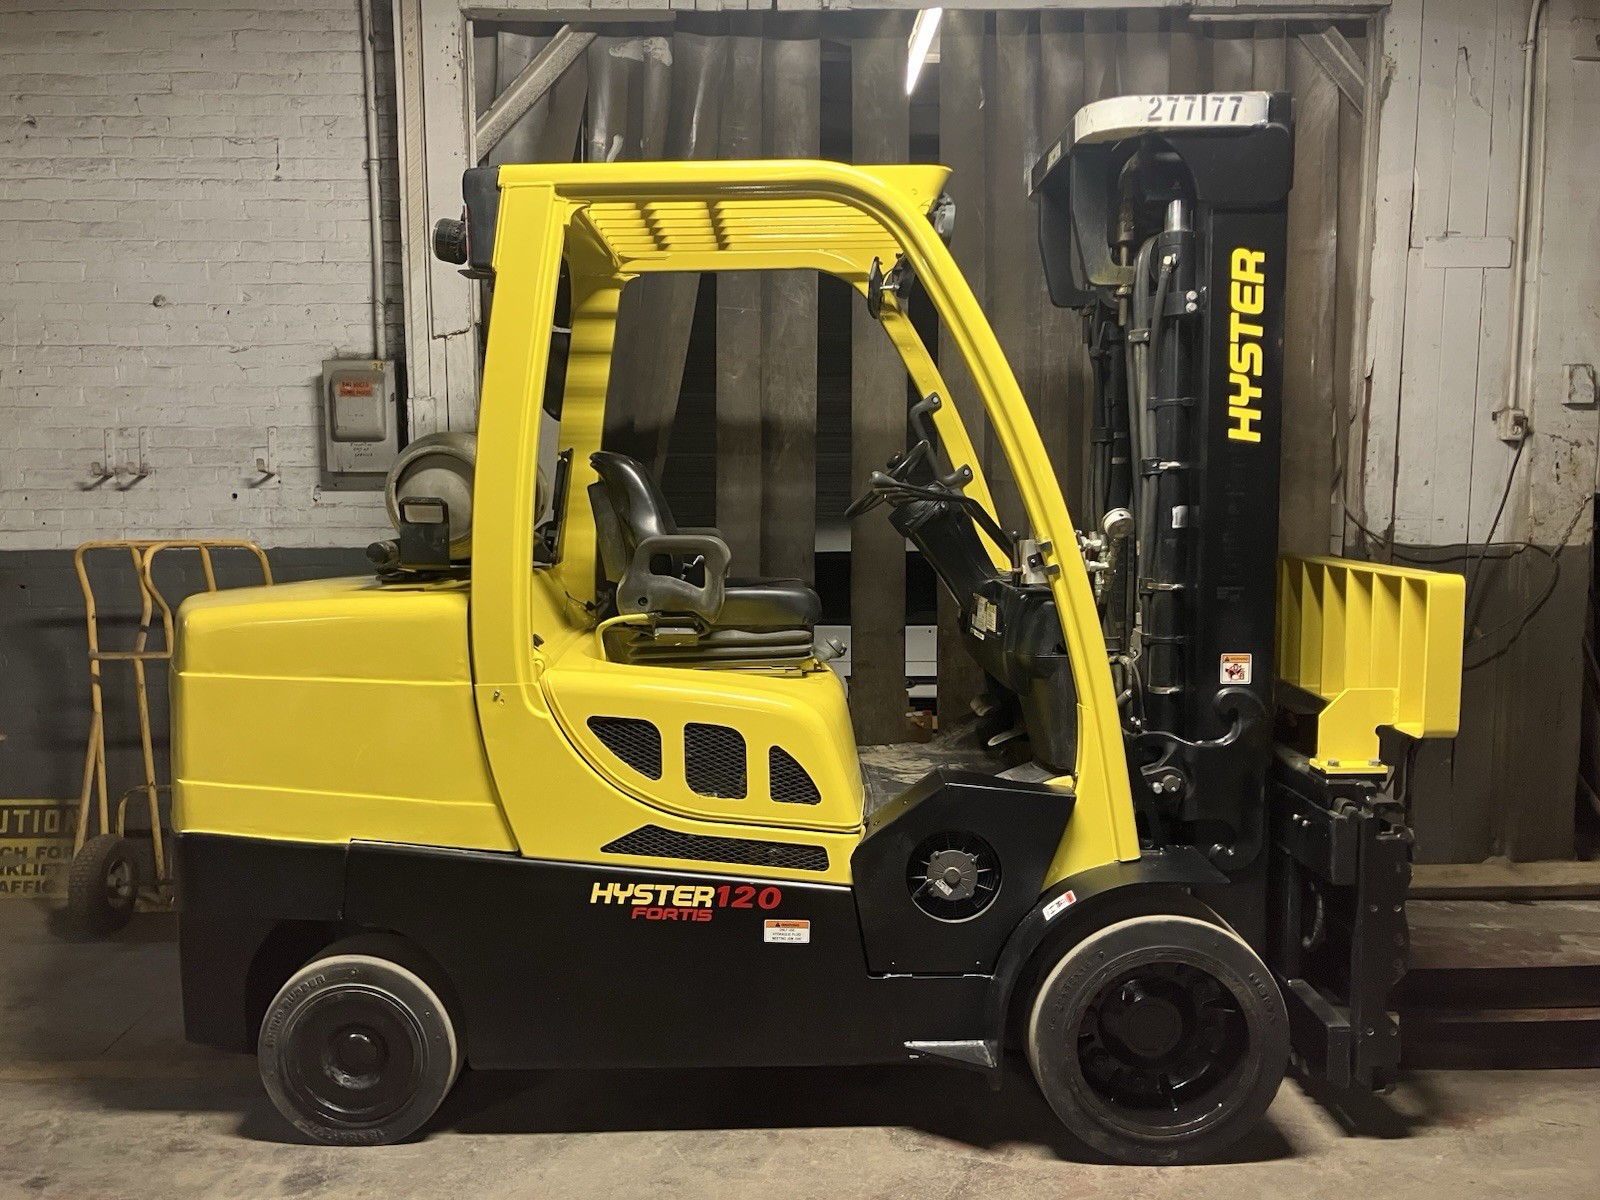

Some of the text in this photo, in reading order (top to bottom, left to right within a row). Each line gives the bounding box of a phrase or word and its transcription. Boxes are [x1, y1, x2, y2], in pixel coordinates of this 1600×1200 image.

[1148, 96, 1243, 122] 277177
[1228, 247, 1265, 443] HYSTER
[589, 882, 782, 910] HYSTER 120
[631, 907, 713, 922] FORTIS
